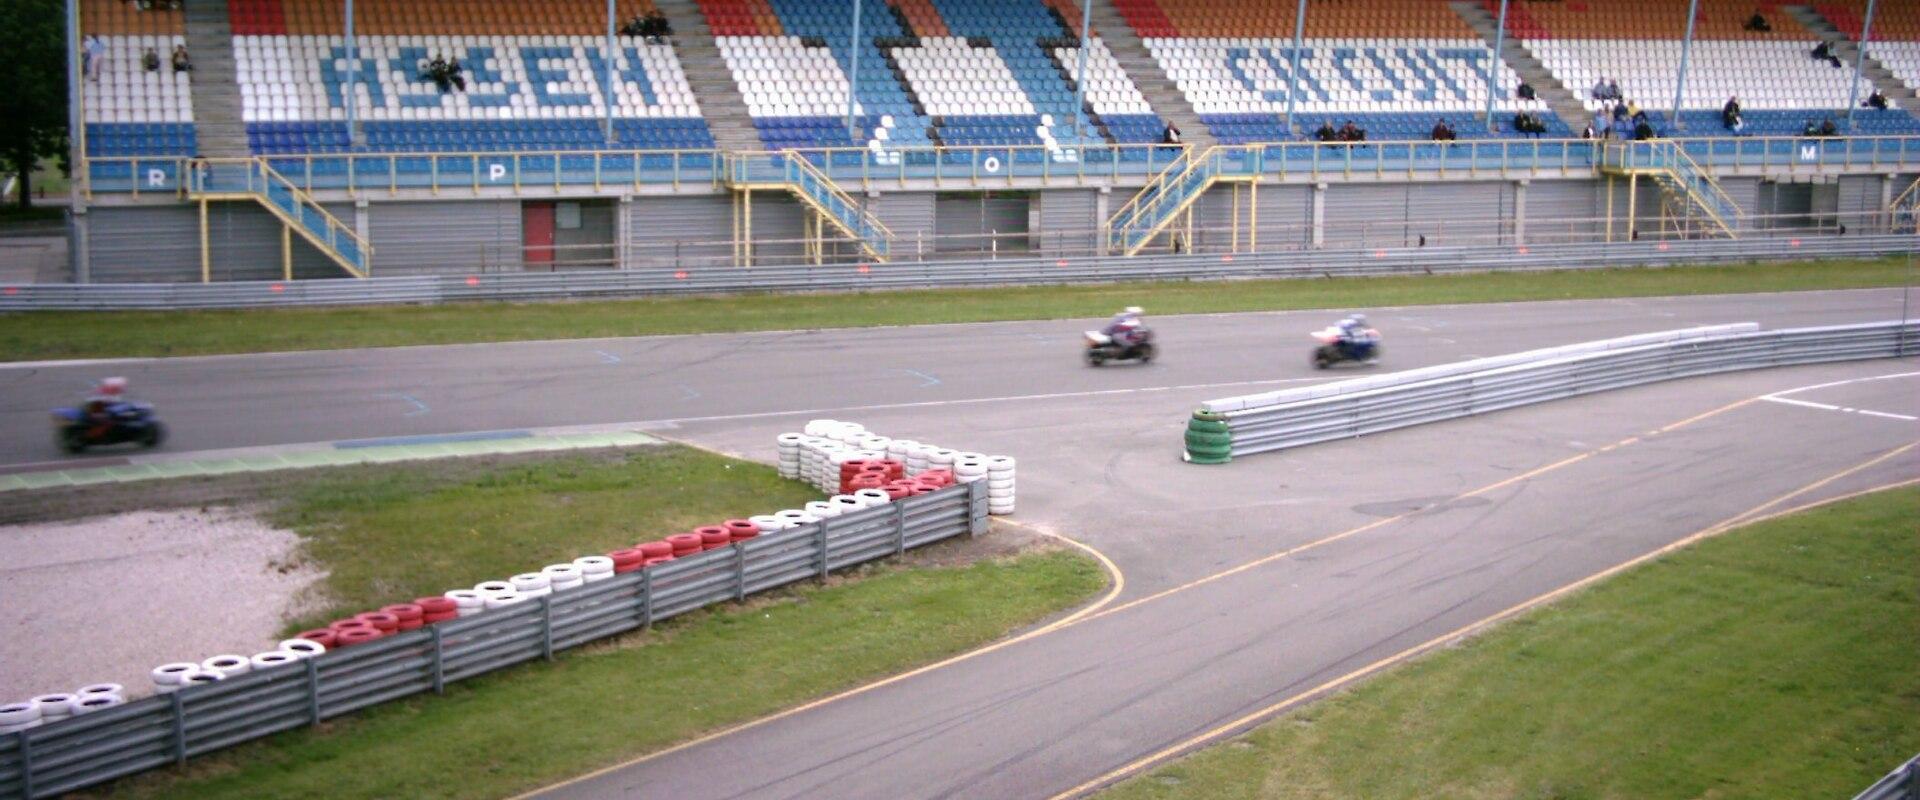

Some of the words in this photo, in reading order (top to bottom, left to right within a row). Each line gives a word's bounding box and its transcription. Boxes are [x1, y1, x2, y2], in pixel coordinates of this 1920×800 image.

[320, 46, 658, 107] ASSEN
[1801, 145, 1817, 160] M
[489, 163, 506, 182] P
[984, 156, 1000, 173] O
[148, 168, 165, 187] R
